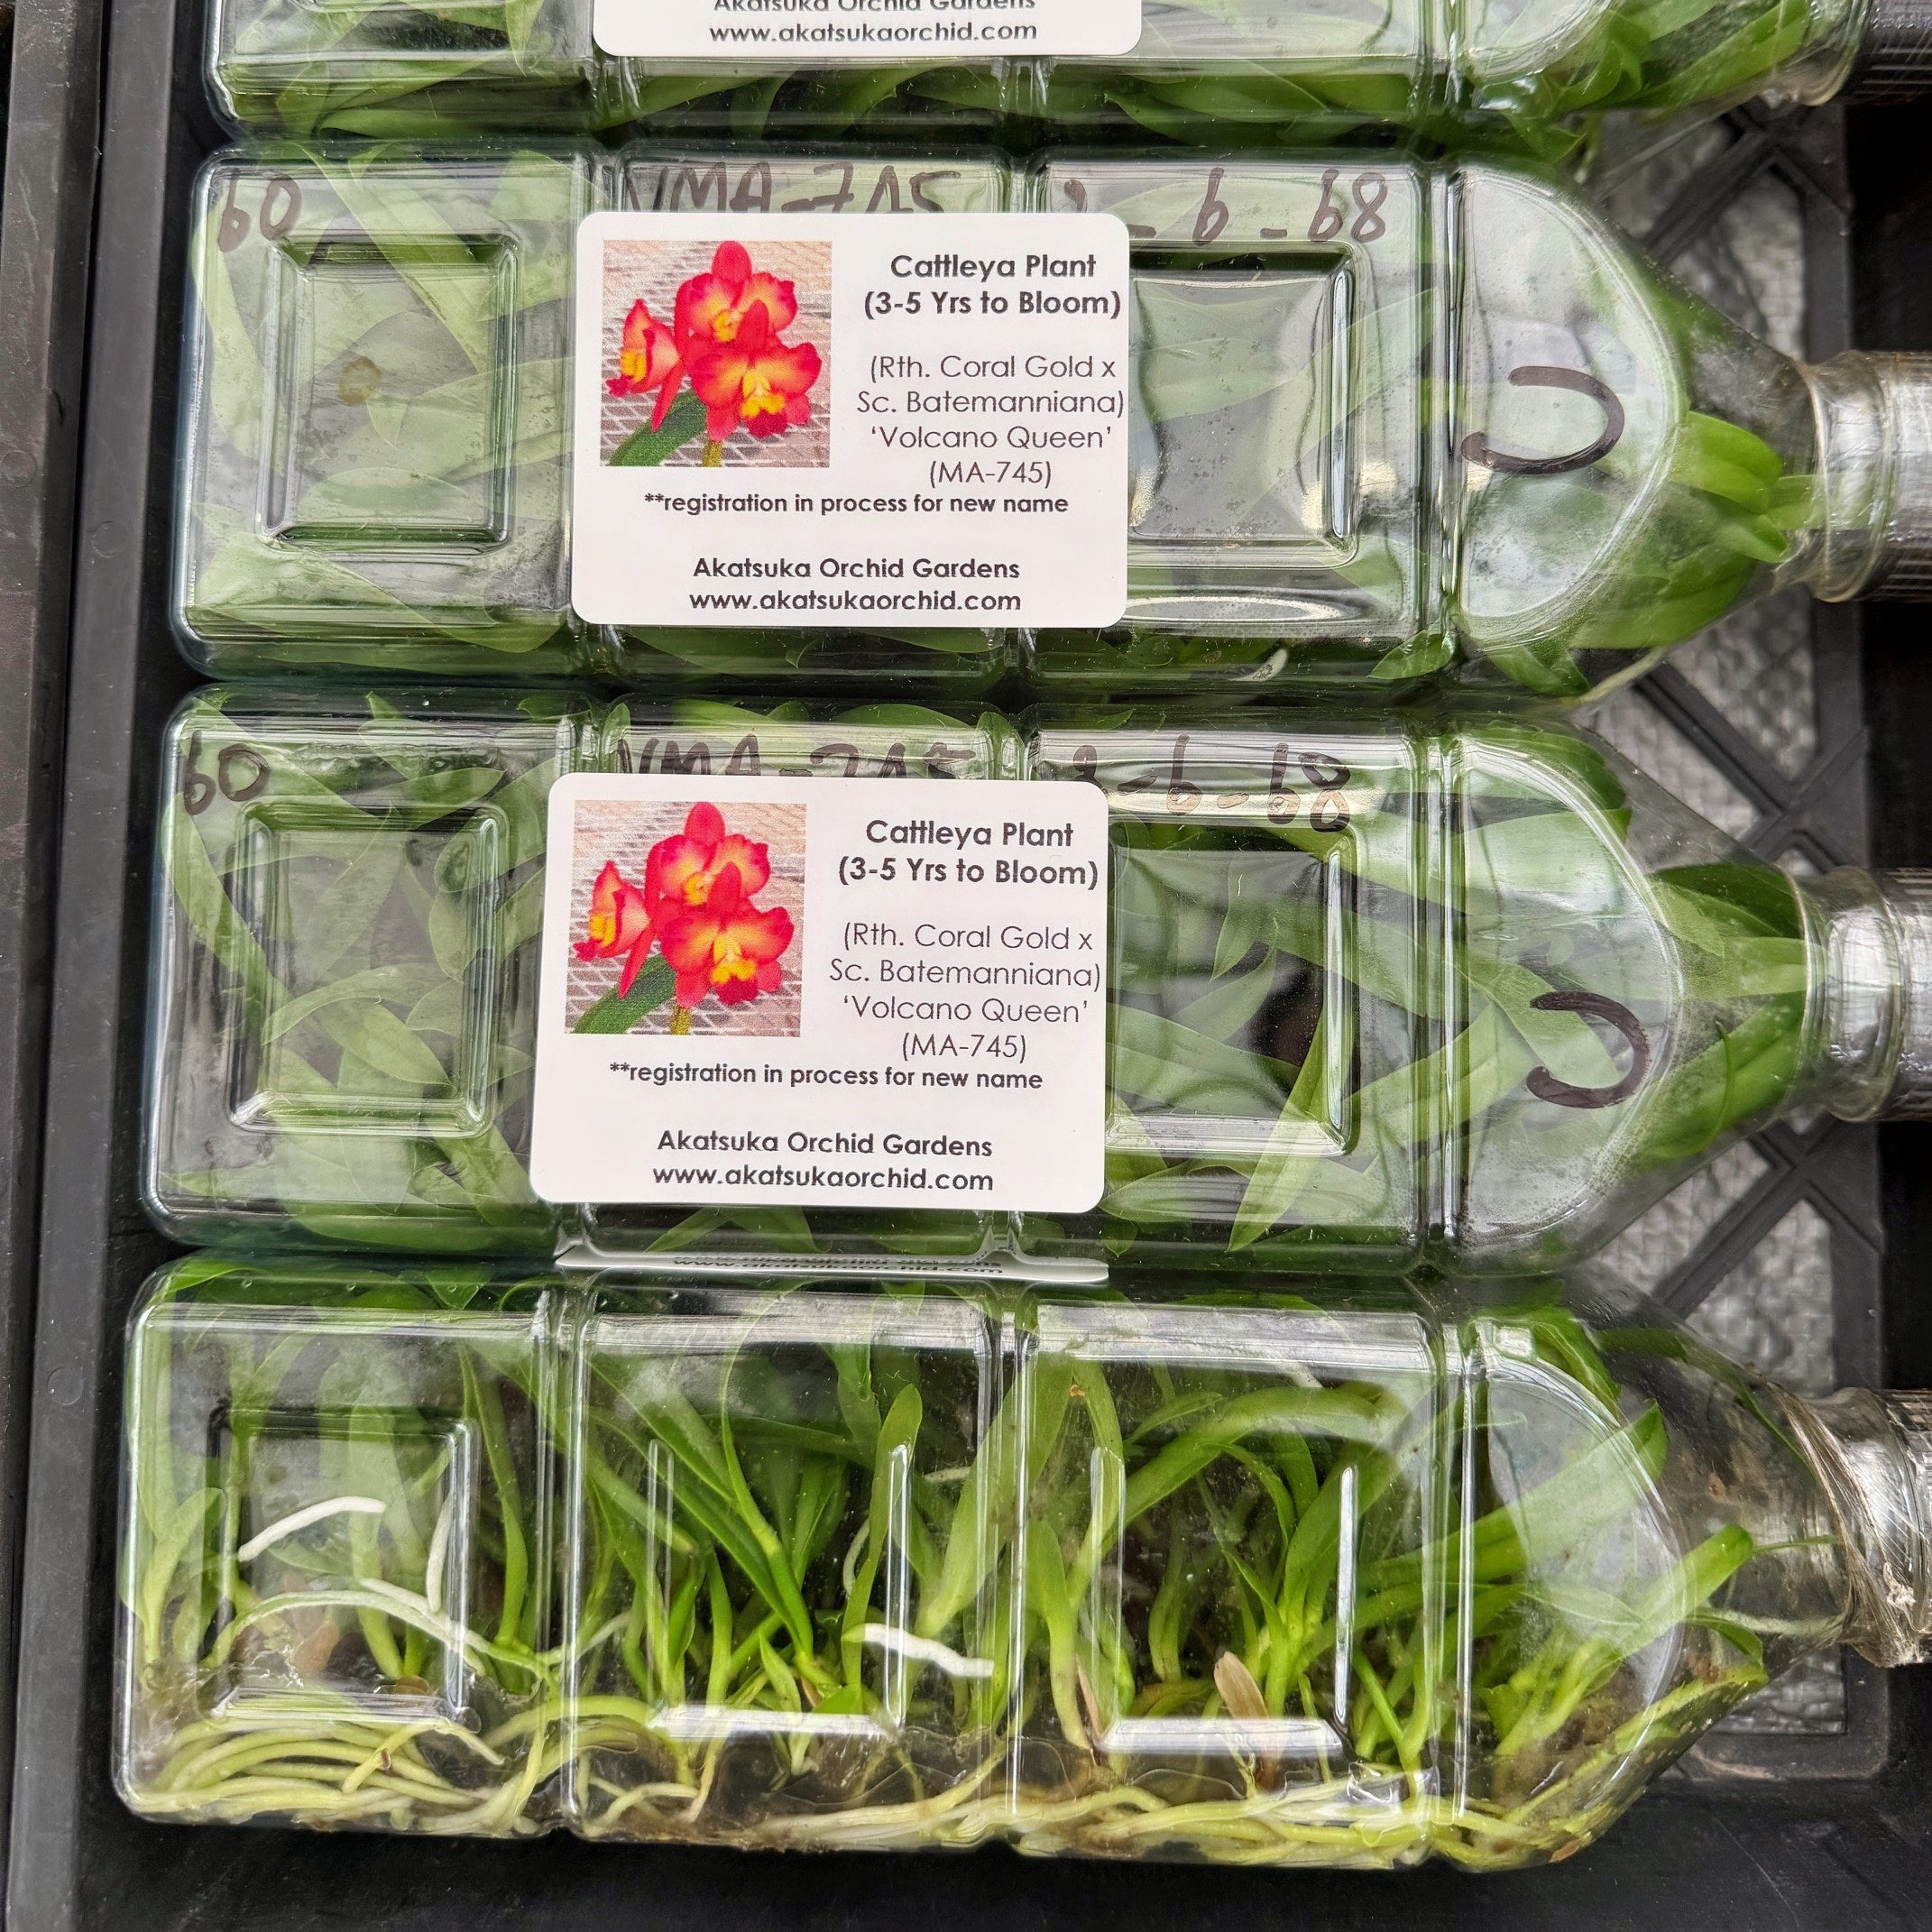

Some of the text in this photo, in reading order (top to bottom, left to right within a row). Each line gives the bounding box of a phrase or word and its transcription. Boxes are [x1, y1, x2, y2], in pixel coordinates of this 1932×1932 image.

[709, 22, 1037, 42] www.akatsukaorchid.com
[890, 253, 1097, 282] Cattleya Plant
[864, 290, 1121, 320] (3-5 Yrs to Bloom)
[870, 354, 1116, 383] (Rth. Coral Gold x
[857, 390, 1125, 419] Sc. Batemanniana)
[930, 460, 1052, 489] (MA-745)
[795, 493, 814, 512] in
[821, 498, 907, 516] process
[913, 493, 943, 512] for
[950, 498, 997, 512] new
[1003, 498, 1069, 513] name
[693, 557, 1020, 579] Akatsuka Orchid Gardens
[689, 589, 1022, 612] www.akatsukaorchid.com
[866, 819, 1074, 849] Cattleya Plant
[838, 855, 1099, 890] (3-5 Yrs to Bloom)
[844, 922, 1093, 952] (Rth. Coral Gold x
[829, 958, 1101, 993] Sc. Batemanniana)
[902, 1032, 1027, 1064] (MA-745)
[764, 1063, 783, 1083] in
[790, 1069, 879, 1089] process
[884, 1066, 915, 1086] for
[922, 1072, 969, 1087] new
[976, 1073, 1044, 1090] name
[657, 1129, 993, 1157] Akatsuka Orchid Gardens
[652, 1164, 994, 1191] www.akatsukaorchid.com
